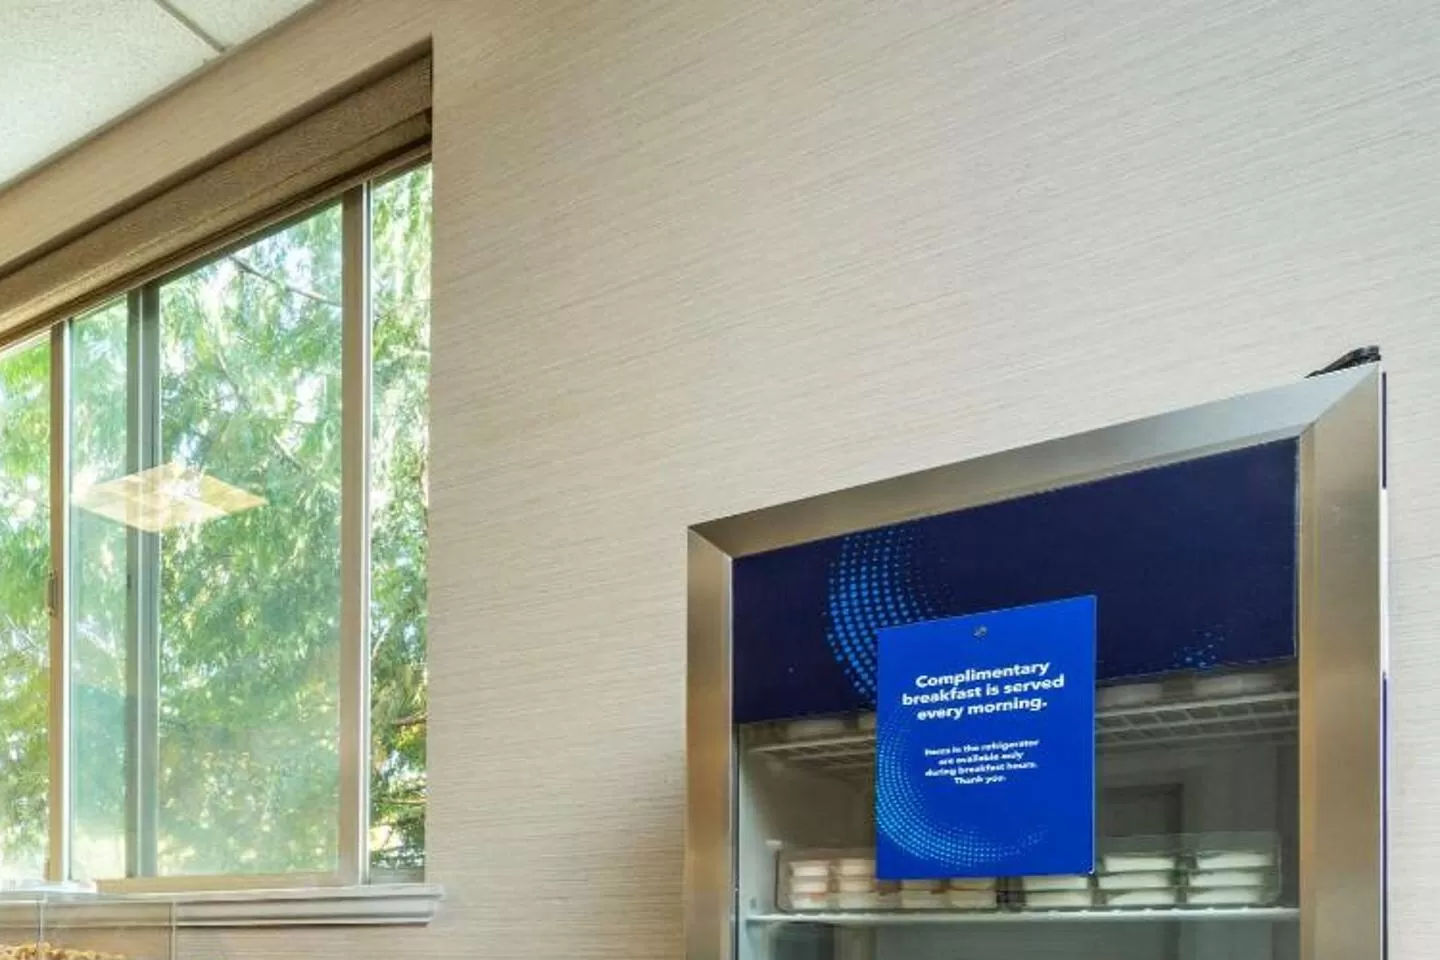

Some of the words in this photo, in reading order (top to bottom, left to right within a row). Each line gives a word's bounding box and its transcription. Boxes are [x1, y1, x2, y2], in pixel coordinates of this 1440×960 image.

[915, 662, 1051, 688] Complimentary
[902, 686, 982, 705] breakfast
[986, 683, 999, 696] is
[1003, 673, 1064, 695] served
[917, 706, 964, 721] every
[967, 697, 1048, 716] morning.
[963, 744, 979, 753] the
[981, 740, 1040, 751] refrigerator
[958, 763, 1005, 775] breakfast
[954, 775, 983, 784] Thank
